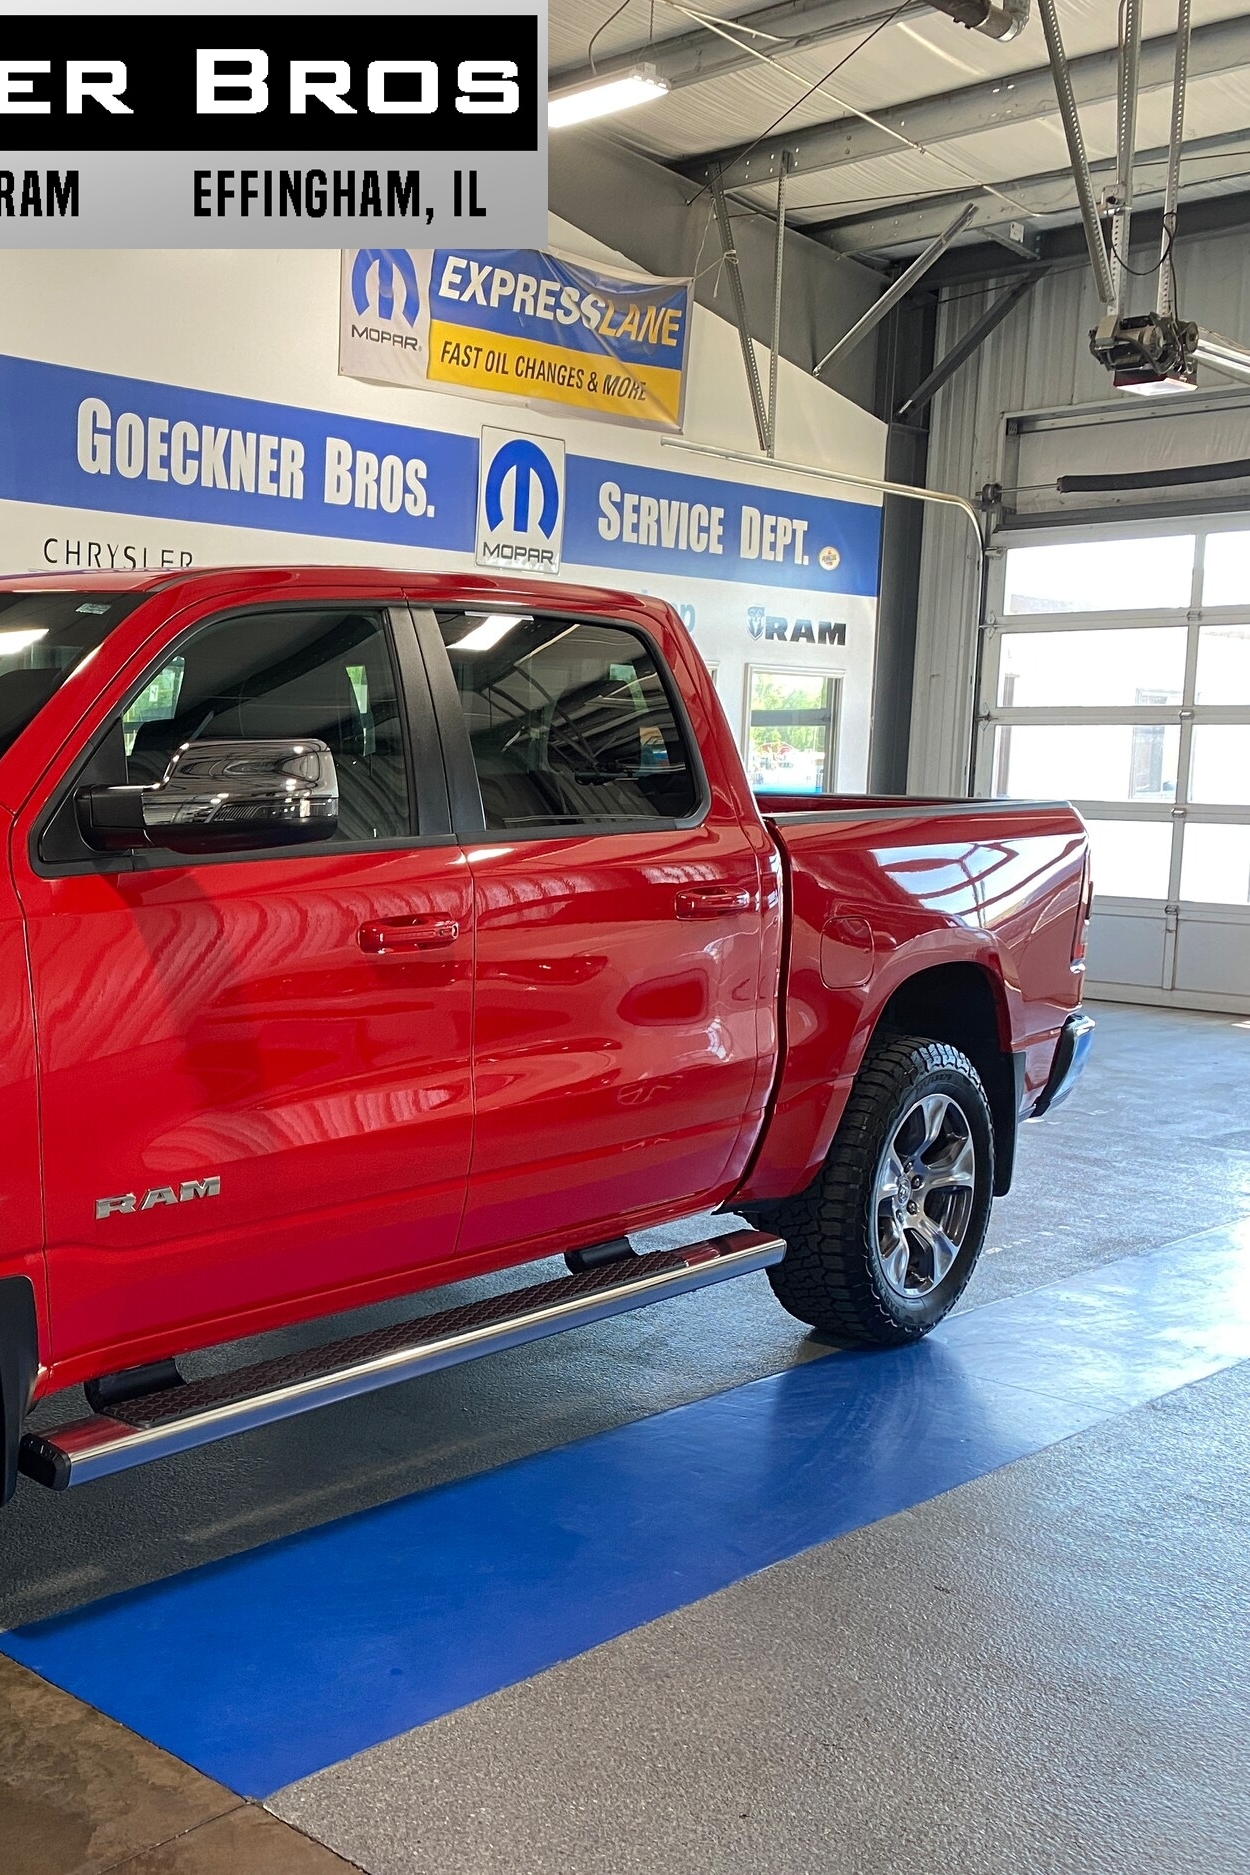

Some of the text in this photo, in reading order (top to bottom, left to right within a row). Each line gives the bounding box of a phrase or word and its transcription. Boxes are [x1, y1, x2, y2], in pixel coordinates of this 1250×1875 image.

[351, 323, 419, 352] MOPAR
[440, 340, 647, 402] FAST OIL CHANGES & MORE
[76, 397, 435, 518] GOECKNER BROS.
[597, 481, 810, 567] SERVICE DEPT.
[43, 537, 193, 571] CHRYSLER
[482, 540, 554, 566] MOPAR
[764, 614, 847, 647] RAM
[94, 1175, 221, 1220] RAM
